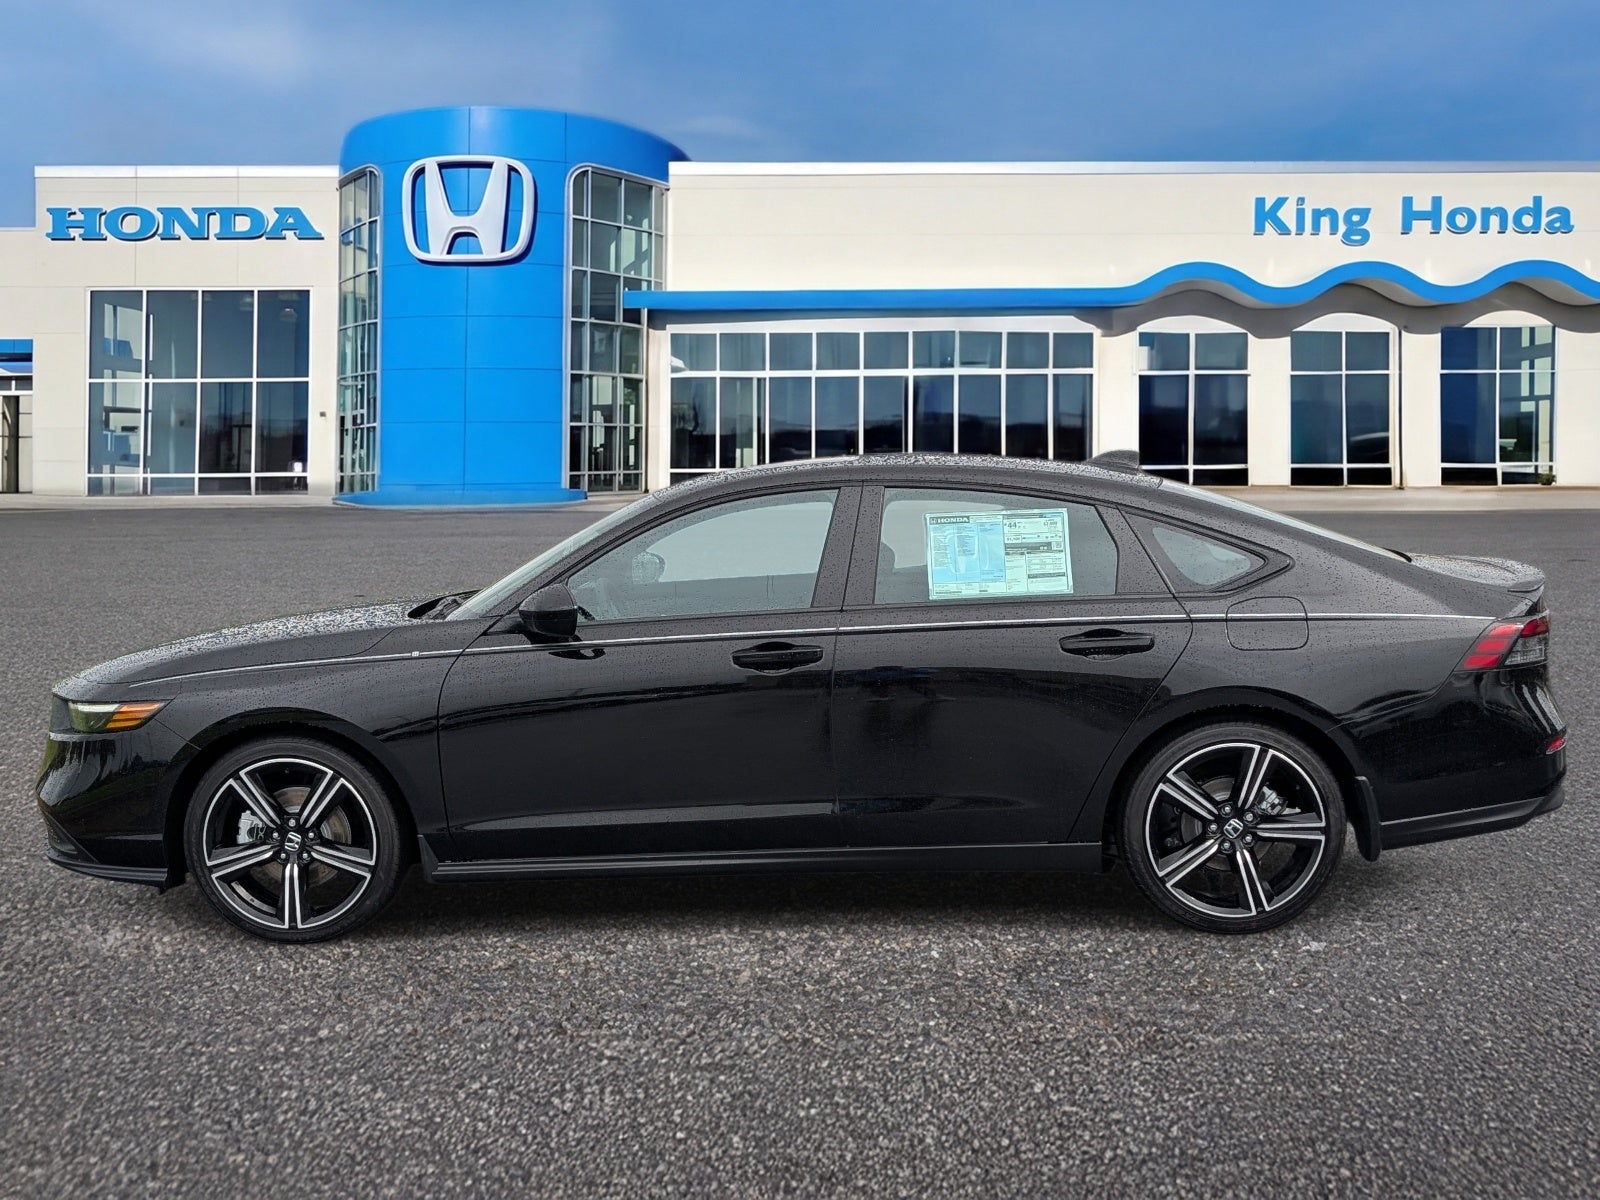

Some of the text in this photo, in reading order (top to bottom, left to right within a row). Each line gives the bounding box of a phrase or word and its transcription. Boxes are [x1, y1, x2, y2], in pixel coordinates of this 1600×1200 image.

[46, 206, 324, 241] HONDA
[1253, 195, 1574, 246] King Honda
[937, 516, 969, 524] HONDA
